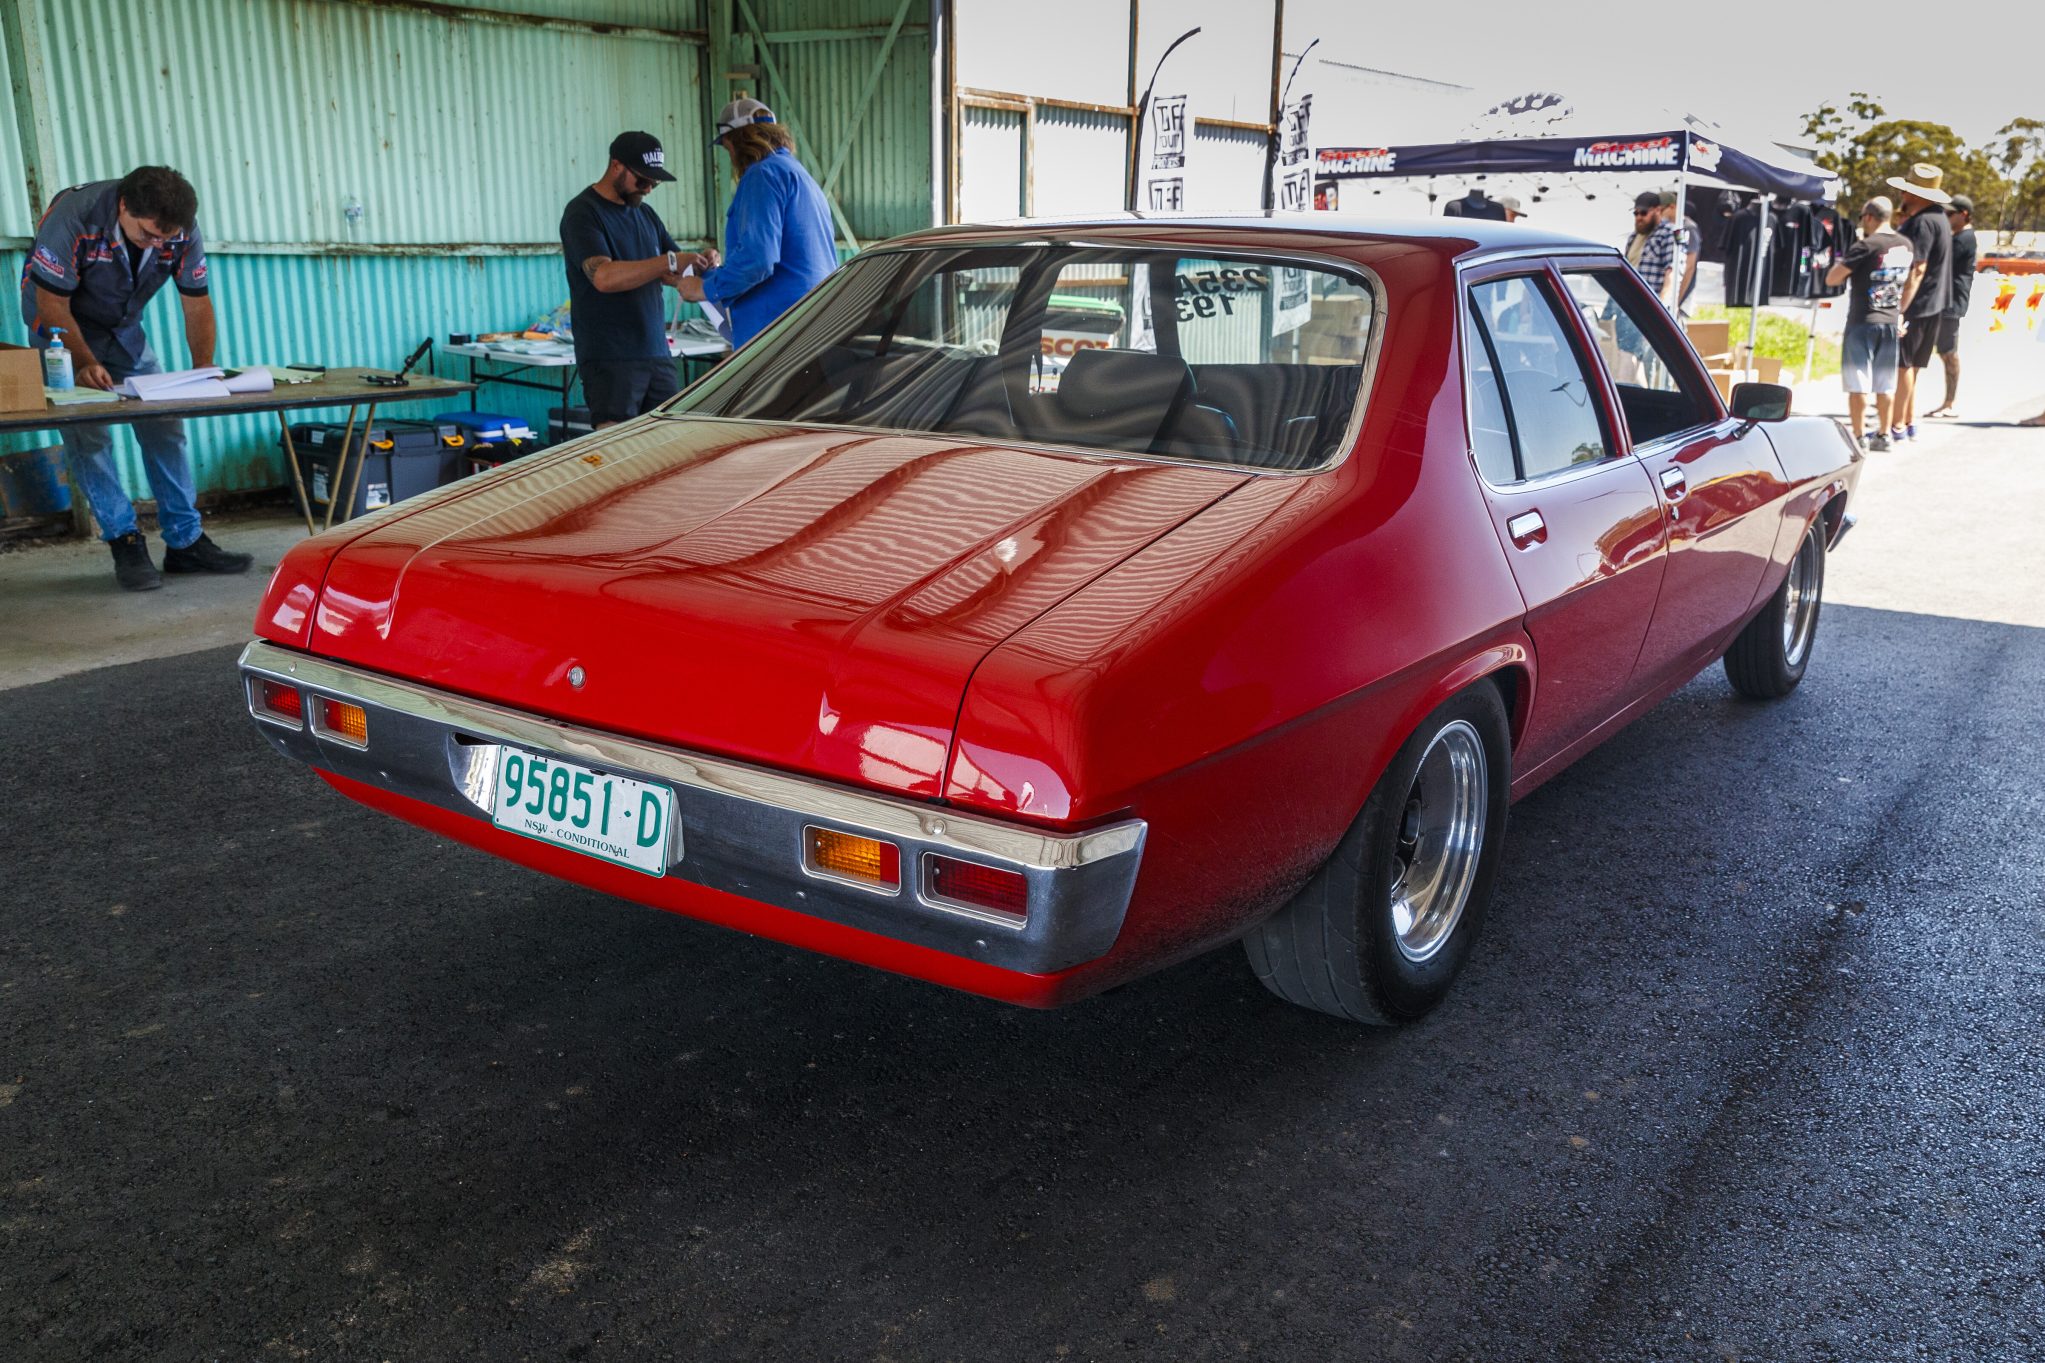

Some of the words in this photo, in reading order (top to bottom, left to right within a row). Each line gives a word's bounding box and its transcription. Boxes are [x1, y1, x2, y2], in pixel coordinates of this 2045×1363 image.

[1573, 143, 1680, 166] MACHINE
[524, 818, 549, 835] NSW
[556, 828, 630, 859] CONDITIONAL
